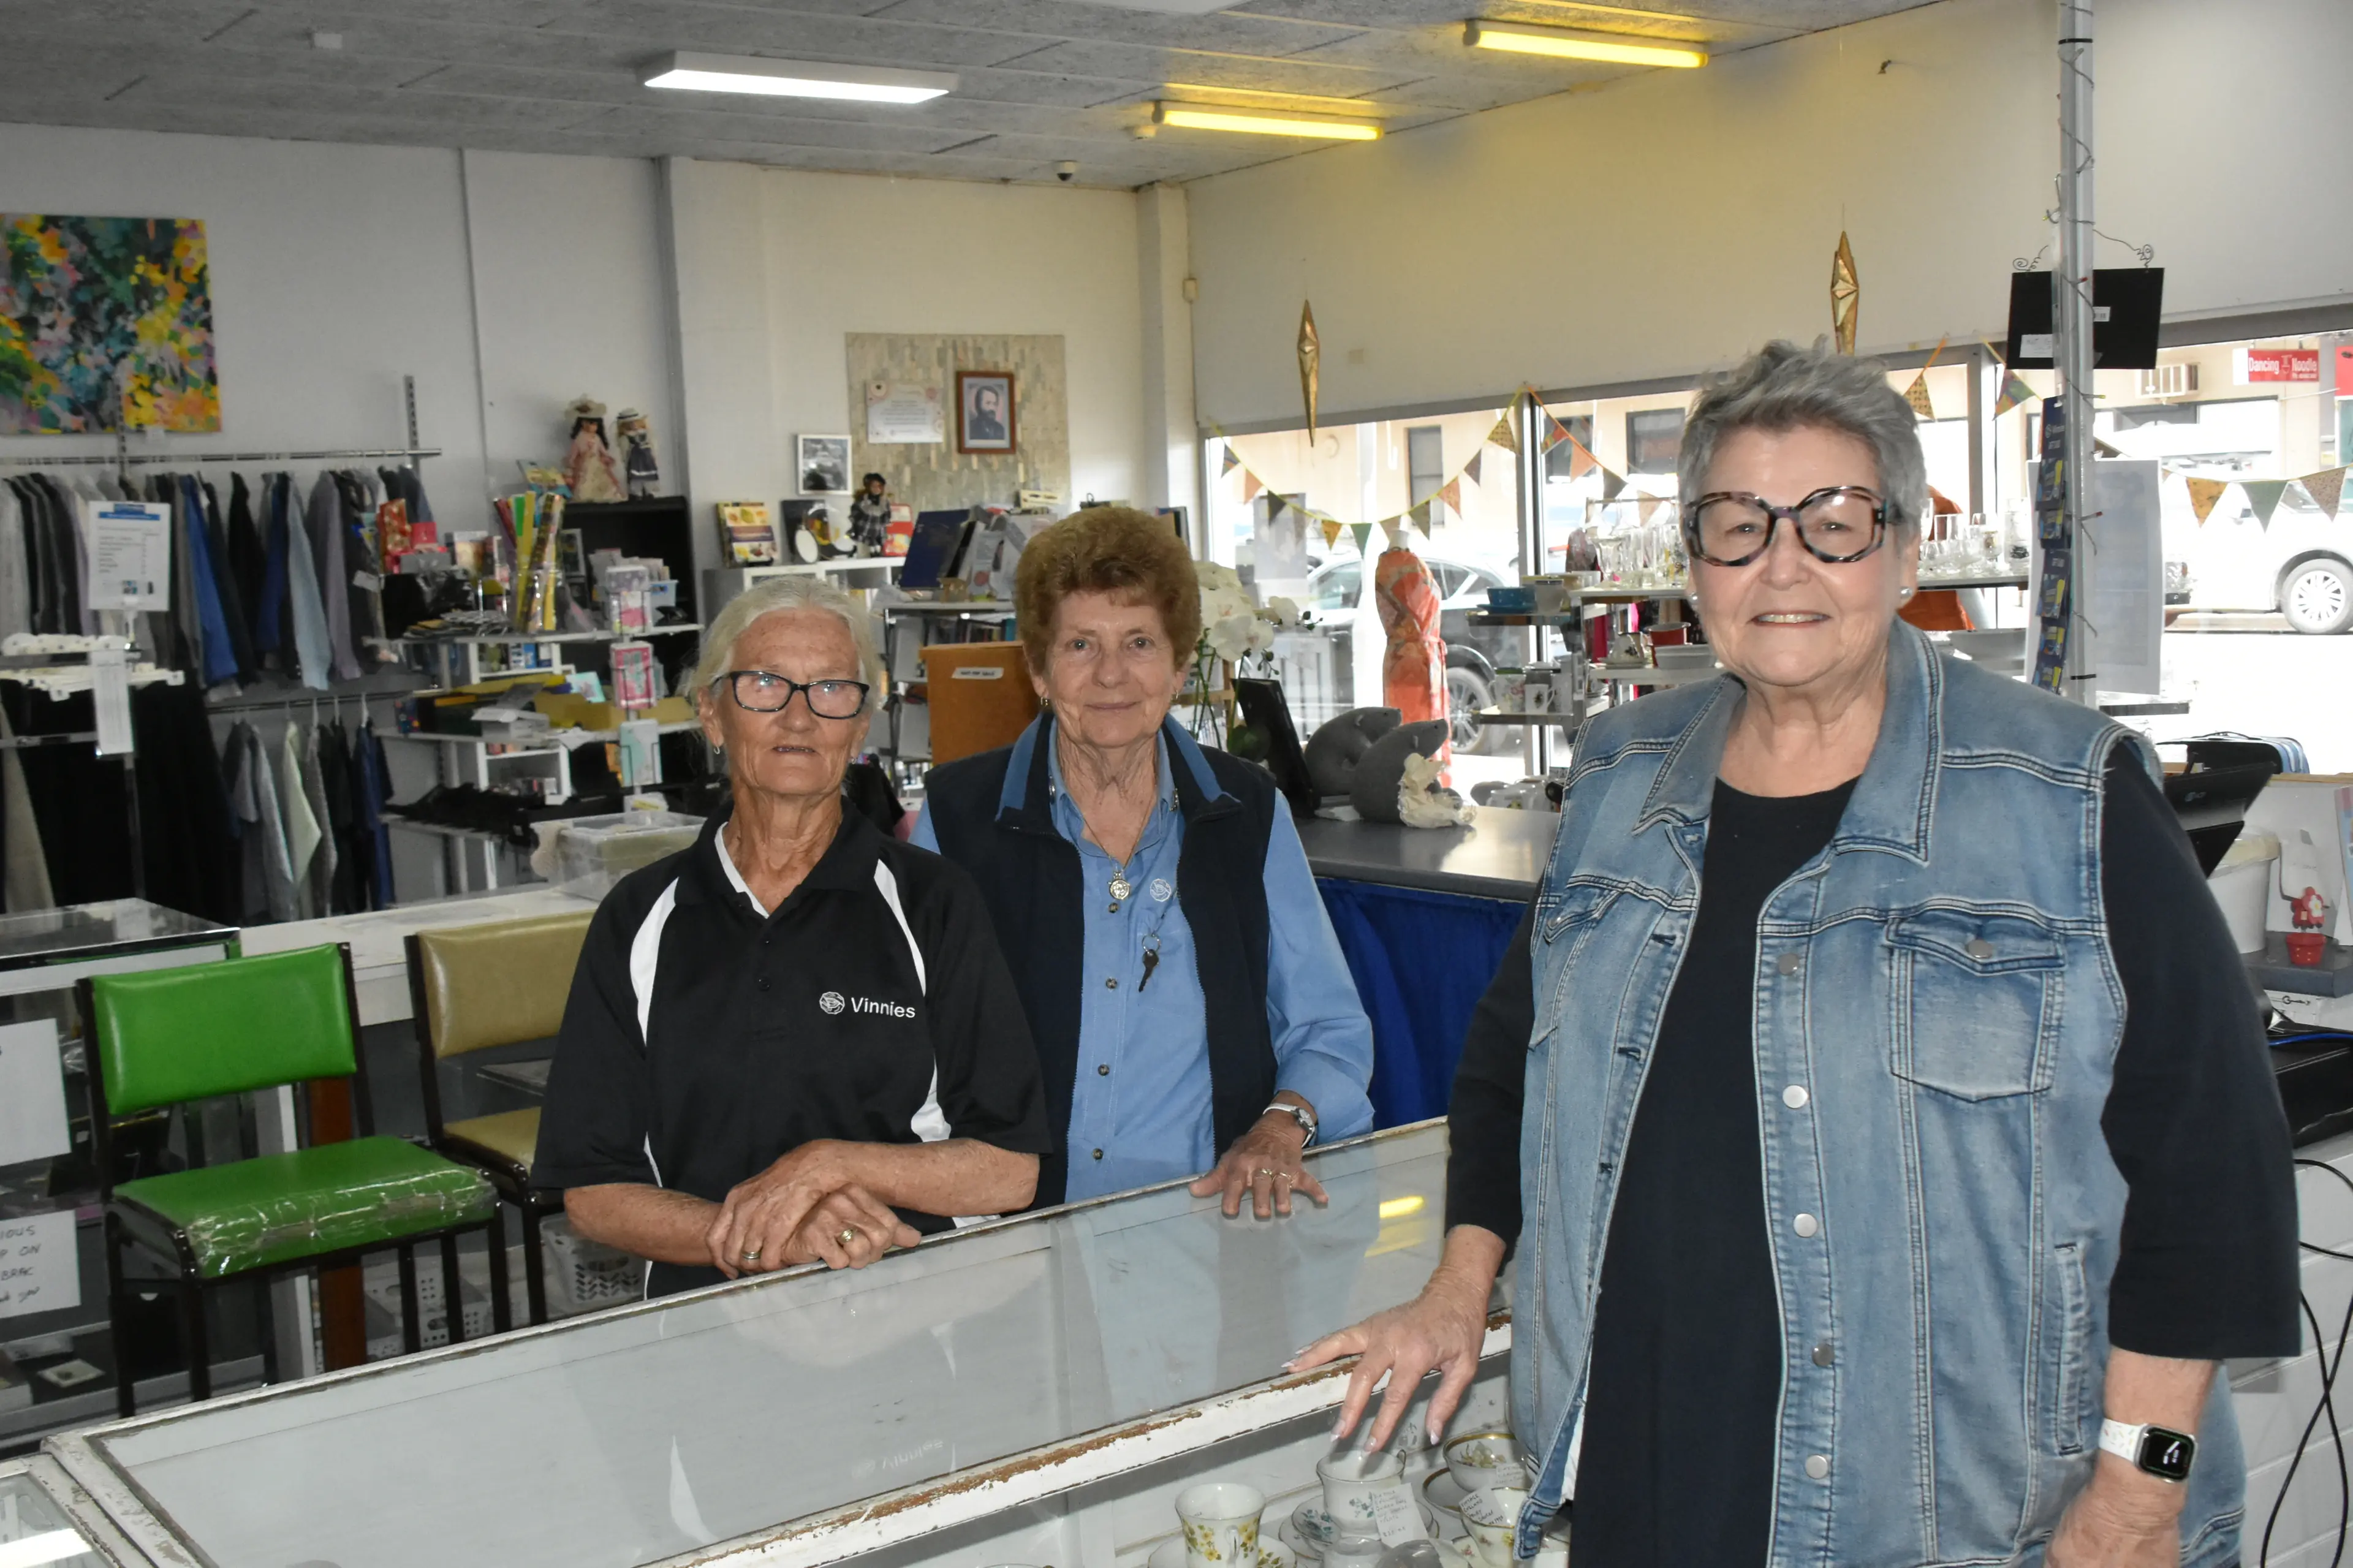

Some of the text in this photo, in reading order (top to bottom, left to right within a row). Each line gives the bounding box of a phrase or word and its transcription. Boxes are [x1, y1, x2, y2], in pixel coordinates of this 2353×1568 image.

[2248, 357, 2317, 375] Dancing Noodle
[851, 997, 916, 1018] Vinnies
